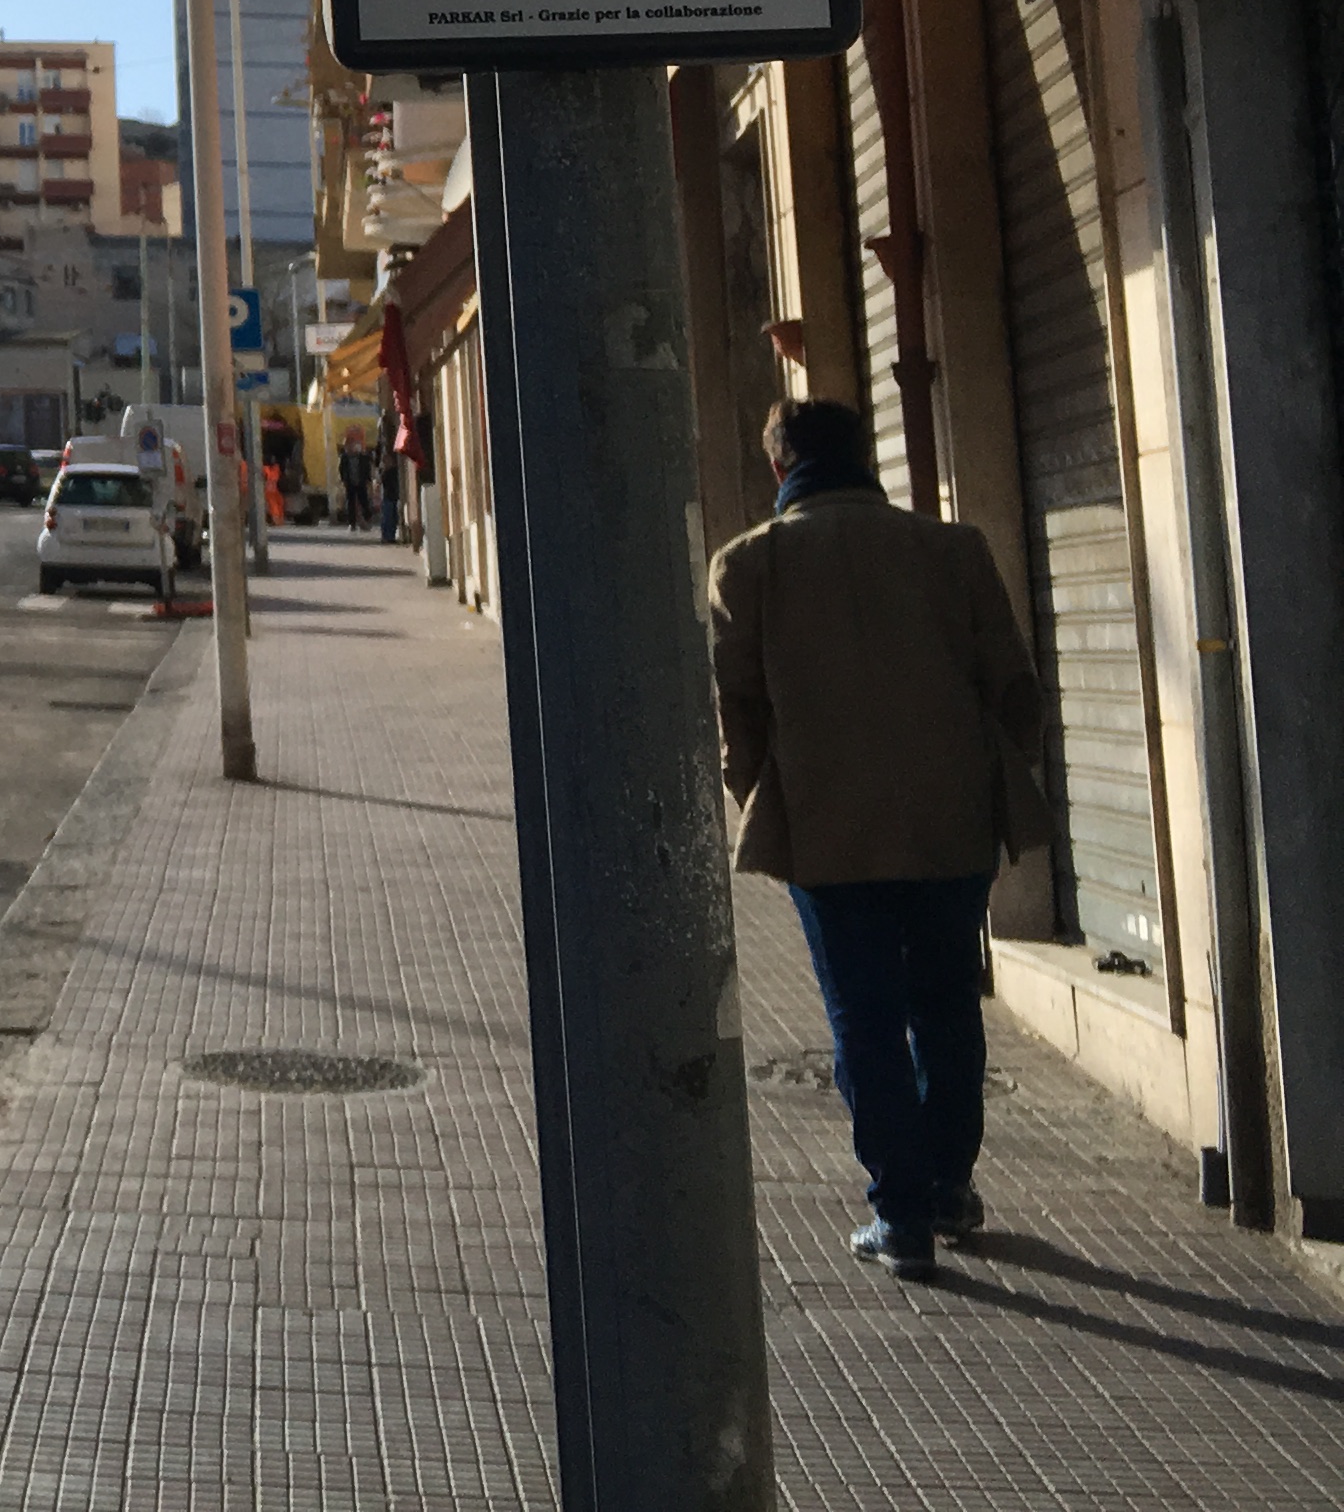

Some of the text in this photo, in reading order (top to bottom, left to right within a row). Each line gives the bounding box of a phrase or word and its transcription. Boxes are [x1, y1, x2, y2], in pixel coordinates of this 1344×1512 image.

[429, 4, 762, 24] PARKAR Srl Grazie per collaborazione
